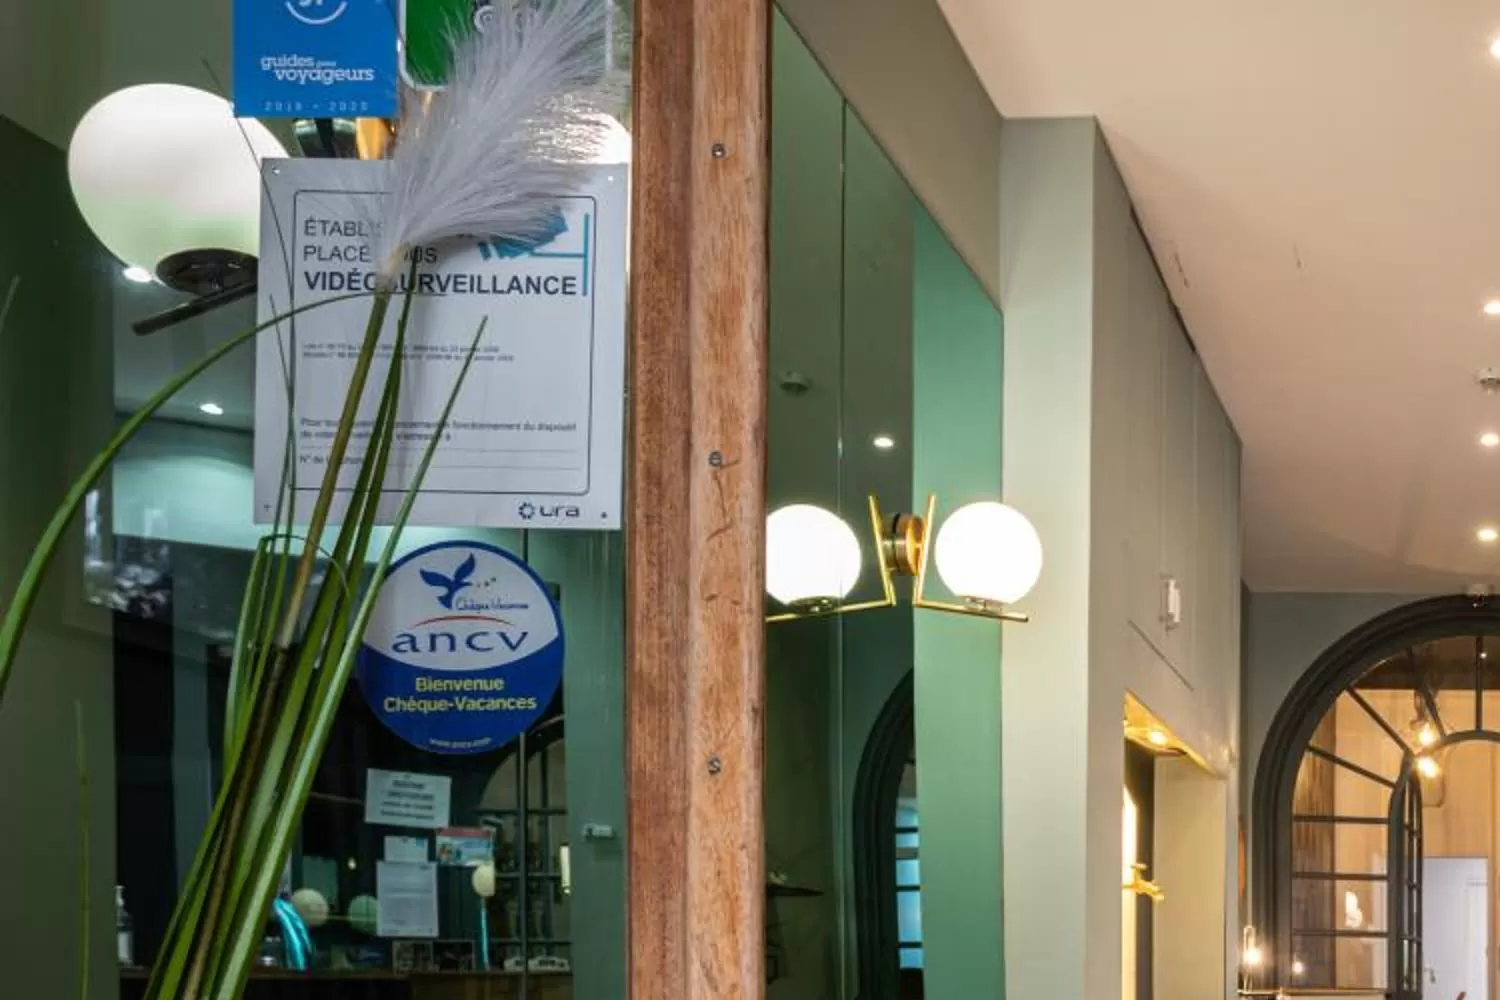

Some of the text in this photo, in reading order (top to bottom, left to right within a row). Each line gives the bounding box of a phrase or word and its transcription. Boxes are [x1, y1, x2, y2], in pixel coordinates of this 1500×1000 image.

[260, 54, 315, 71] guides
[274, 67, 376, 85] voyageurs
[392, 631, 529, 653] ancv
[415, 677, 504, 692] Bienvenue
[384, 696, 537, 714] Chèque-Vacances
